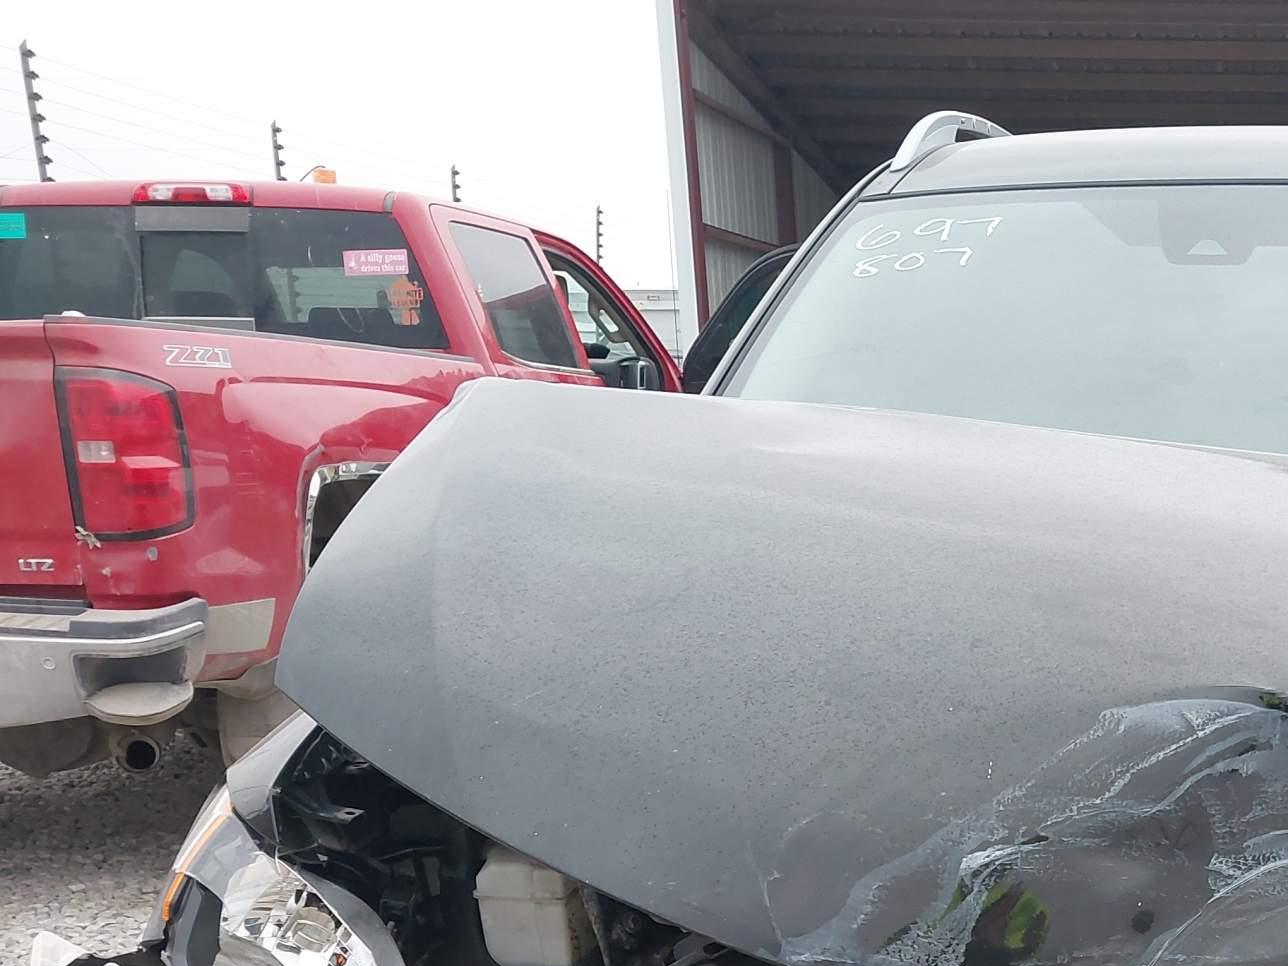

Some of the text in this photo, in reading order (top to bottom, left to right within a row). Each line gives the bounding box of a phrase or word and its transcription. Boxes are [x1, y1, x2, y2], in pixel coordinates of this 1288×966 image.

[855, 216, 1003, 250] 697
[367, 252, 383, 265] silly
[852, 246, 974, 277] 807
[18, 558, 55, 572] LTZ
